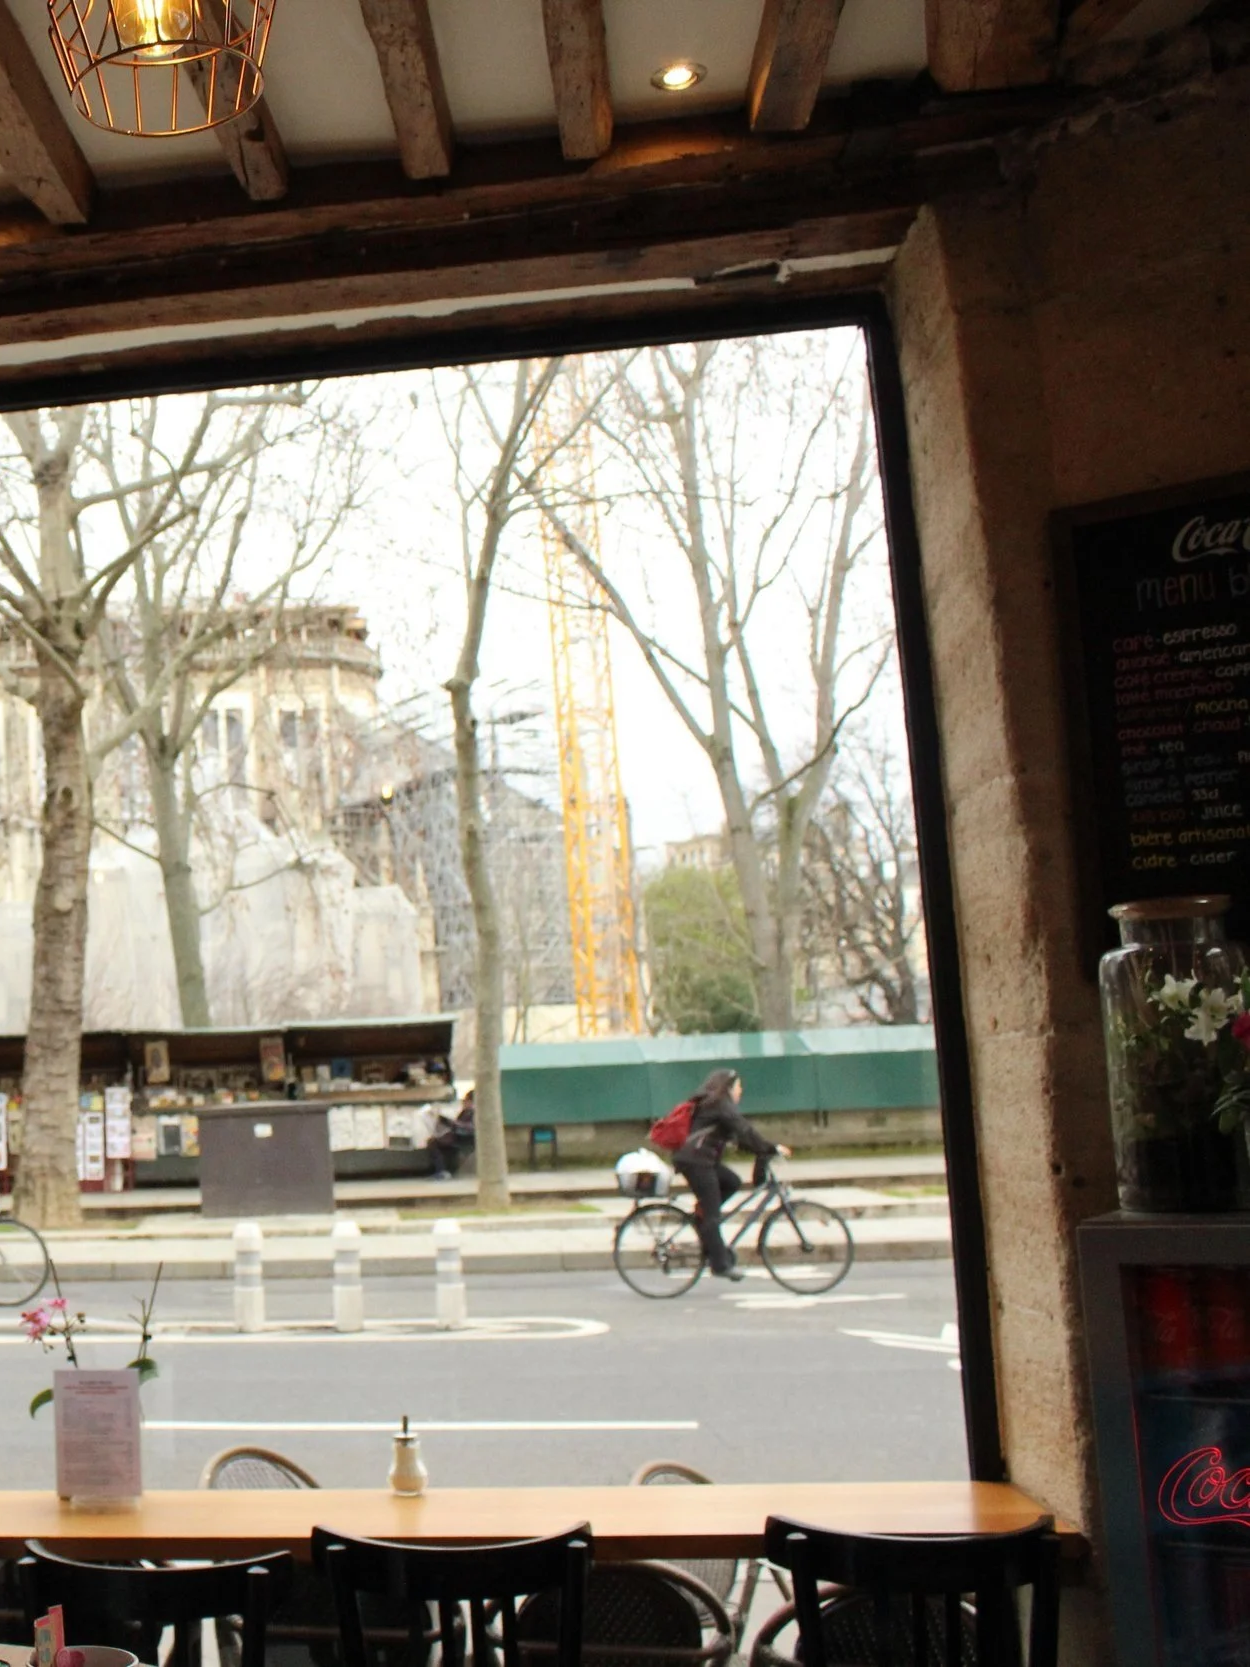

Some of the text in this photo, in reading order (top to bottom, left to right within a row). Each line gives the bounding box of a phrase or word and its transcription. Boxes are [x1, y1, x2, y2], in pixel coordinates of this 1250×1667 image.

[1135, 570, 1216, 612] menu
[1162, 622, 1237, 646] espresso
[1193, 698, 1248, 714] mocha
[1201, 803, 1243, 820] juice
[1131, 850, 1239, 871] cidre cider
[1157, 1446, 1250, 1528] Coc
